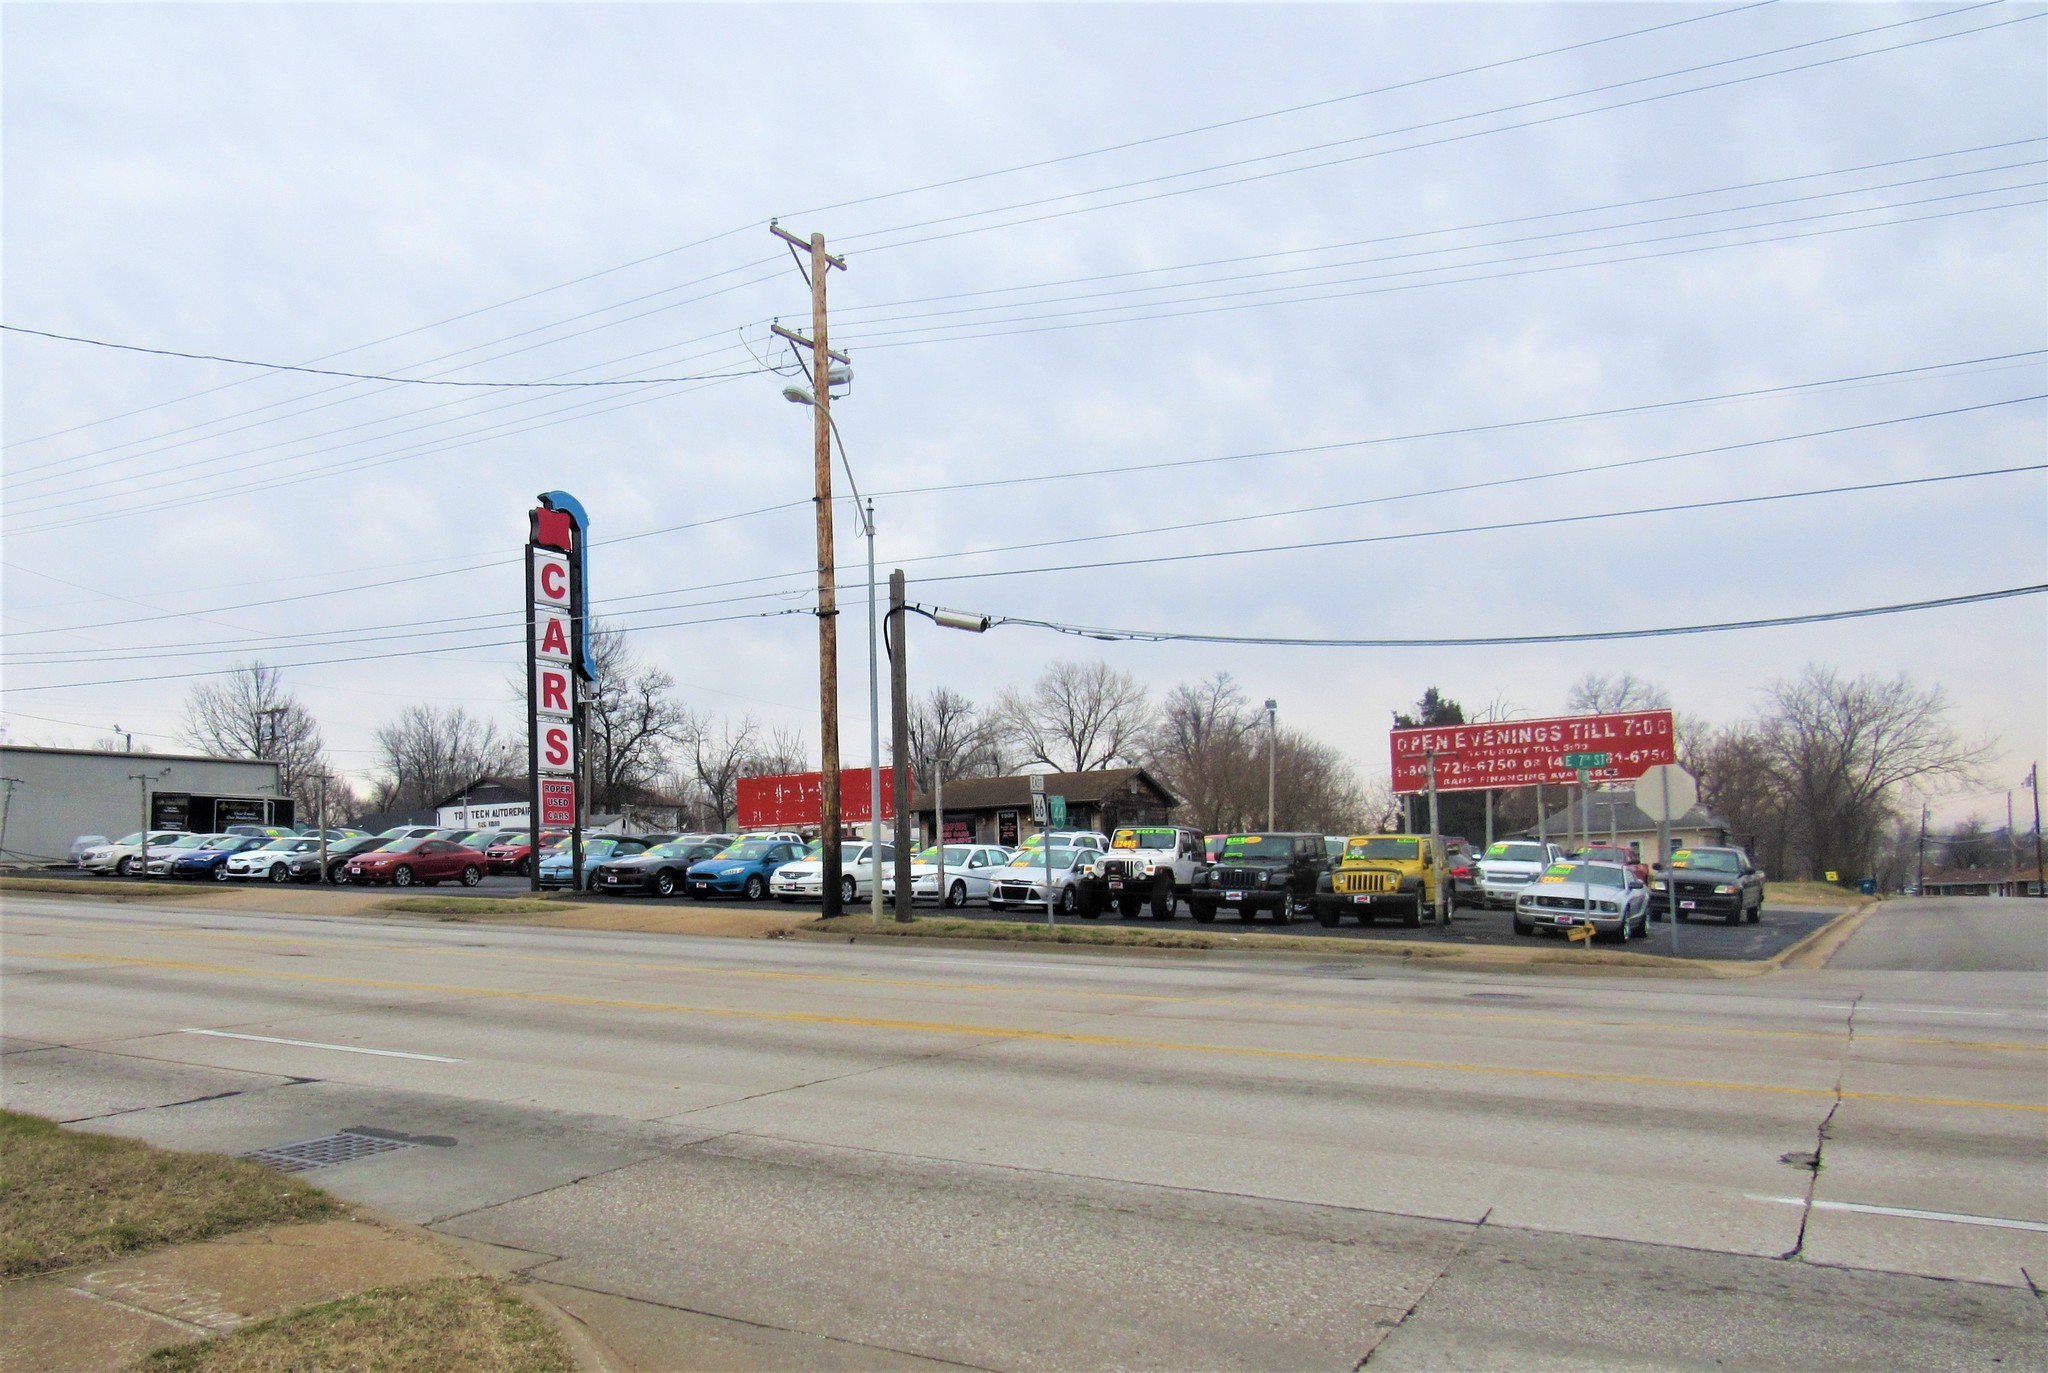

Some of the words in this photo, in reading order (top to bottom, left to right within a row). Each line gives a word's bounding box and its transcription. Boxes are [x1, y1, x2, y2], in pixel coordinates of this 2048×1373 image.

[541, 563, 570, 766] CARS
[1397, 734, 1448, 752] OPEN
[1455, 725, 1562, 748] EVENINGS
[1569, 721, 1616, 740] TILL
[1623, 719, 1668, 736] 7:00
[1532, 744, 1559, 754] TILL
[1565, 755, 1572, 767] E
[1593, 754, 1606, 766] ST
[1395, 758, 1517, 778] 1-80-726-6750
[1523, 758, 1541, 770] OR
[1479, 772, 1547, 784] FINANCING
[544, 783, 572, 795] ROPER
[547, 798, 570, 807] USED
[1034, 799, 1045, 818] 66
[471, 809, 490, 819] TECH
[547, 811, 570, 820] CARS
[1053, 806, 1064, 821] 44
